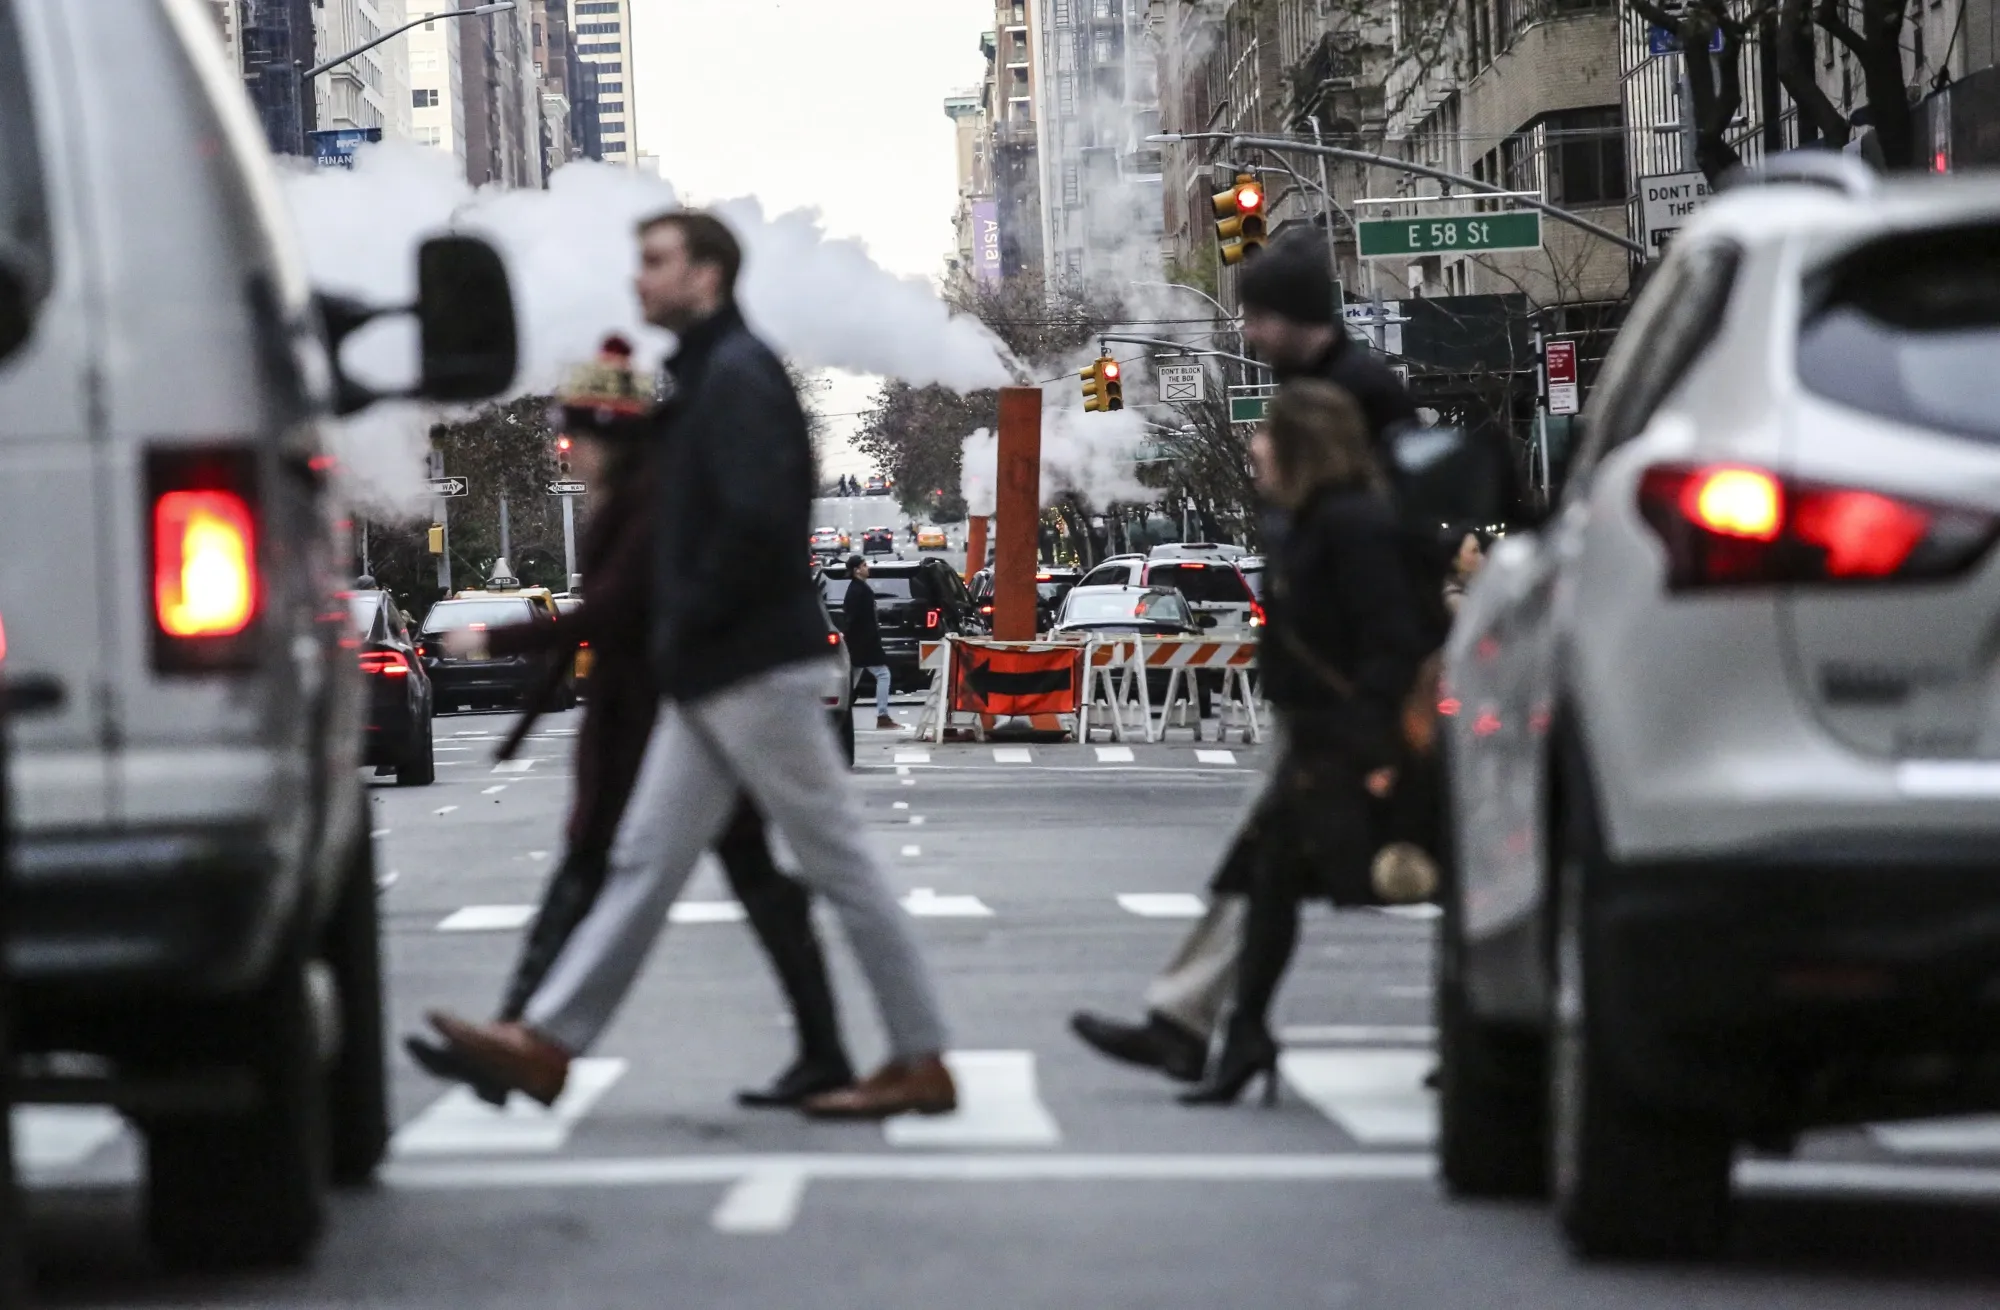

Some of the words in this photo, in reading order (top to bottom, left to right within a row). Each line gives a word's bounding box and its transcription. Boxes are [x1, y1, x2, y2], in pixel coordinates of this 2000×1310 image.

[318, 155, 353, 165] FINAN
[1648, 184, 1691, 202] DON'T
[1668, 201, 1695, 217] THE
[983, 220, 999, 261] Asia
[1408, 225, 1421, 248] E
[1431, 223, 1457, 247] 58
[1467, 221, 1490, 245] St
[1161, 367, 1179, 375] DON'T
[1181, 366, 1201, 374] BLOCK
[442, 483, 459, 491] WAY
